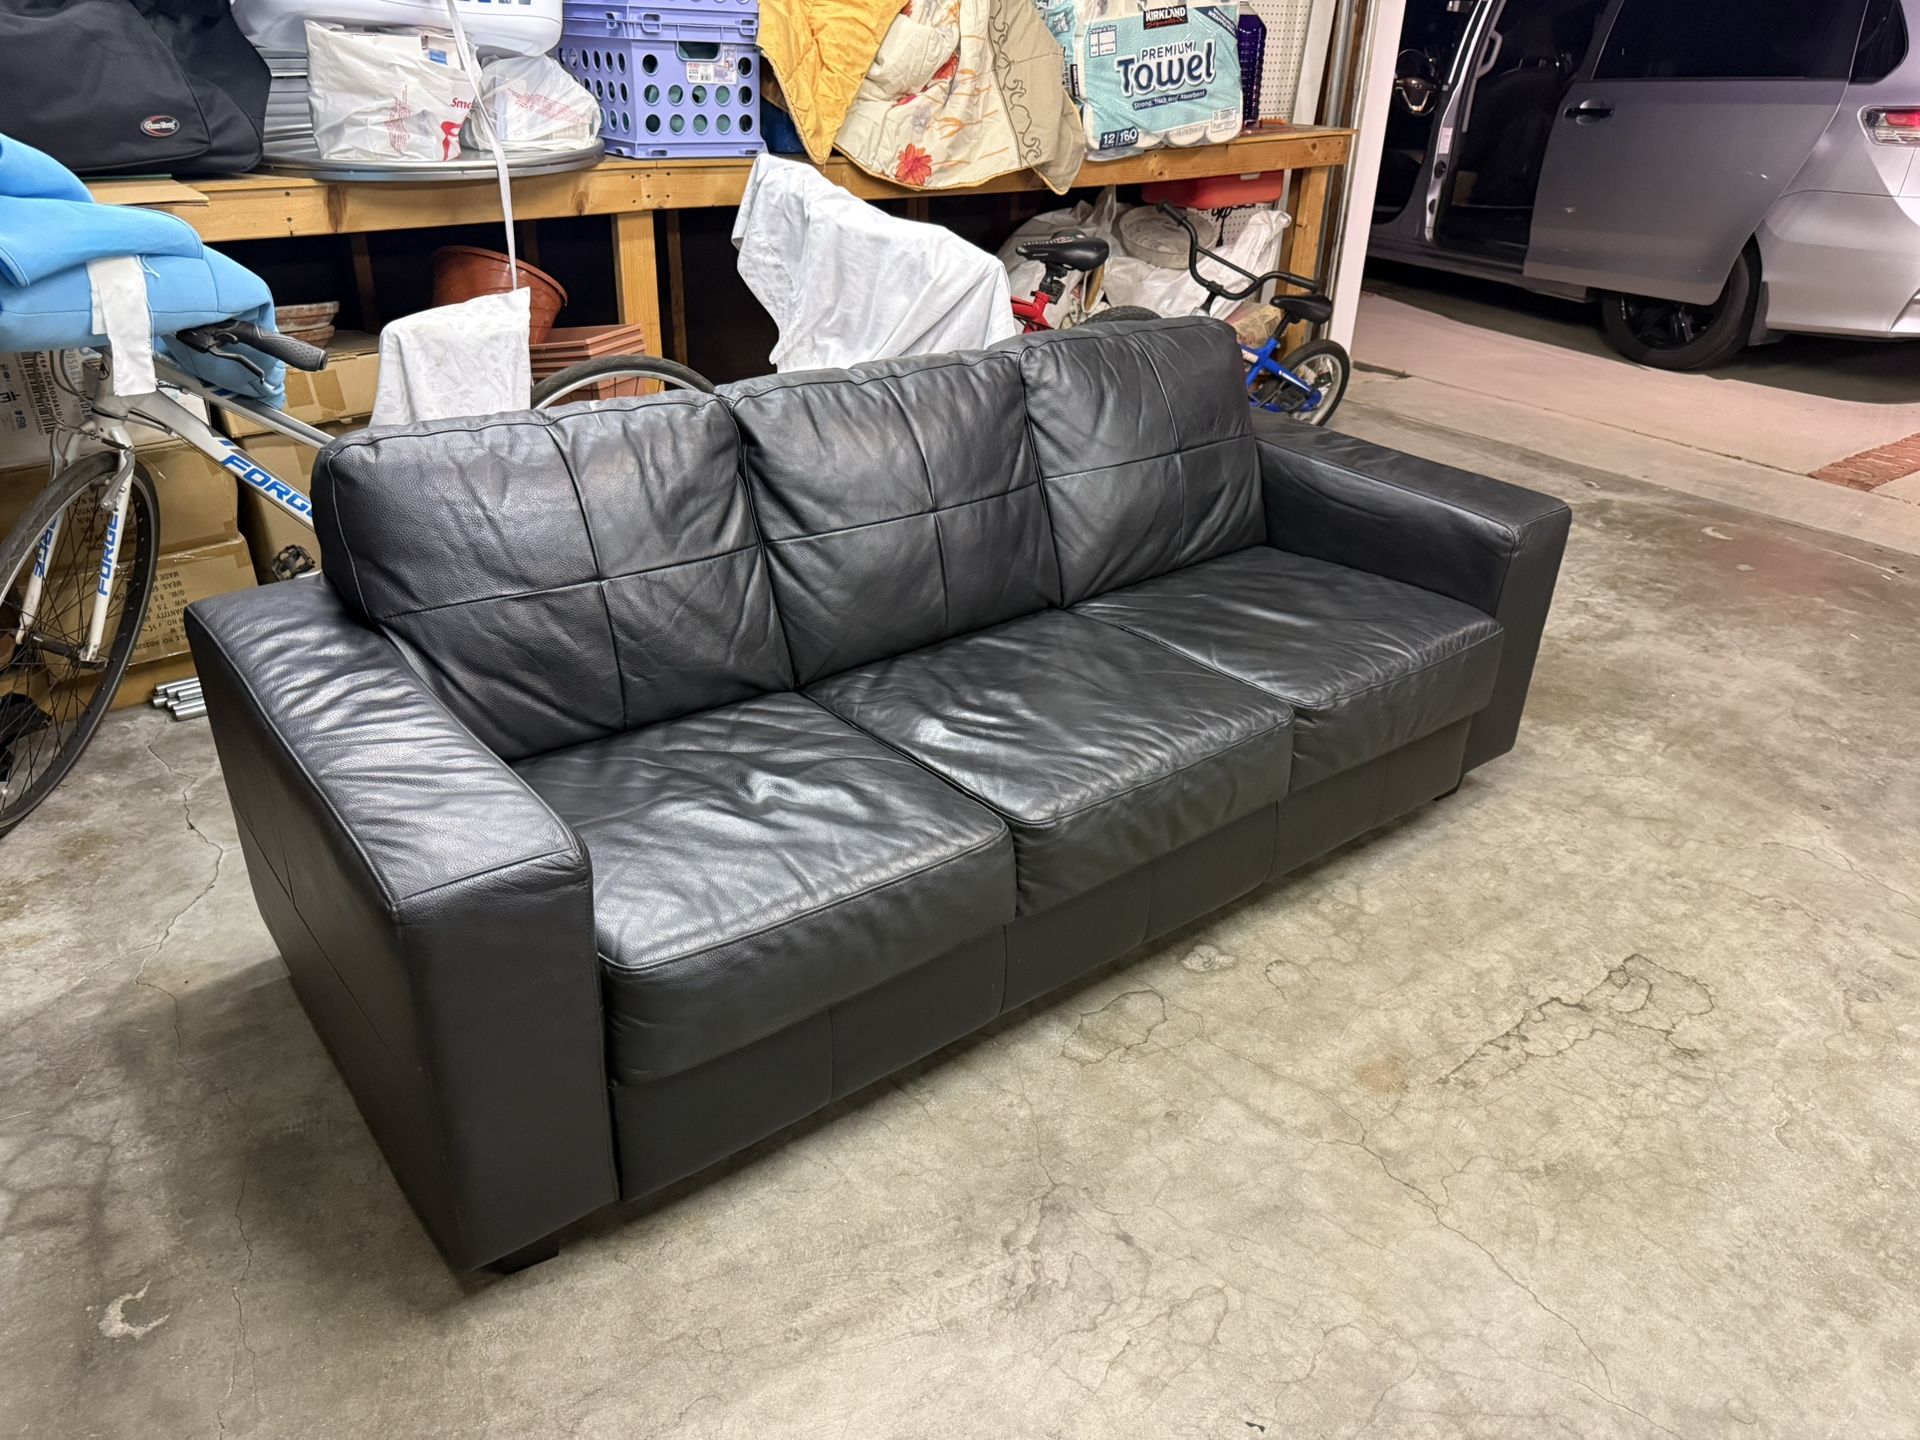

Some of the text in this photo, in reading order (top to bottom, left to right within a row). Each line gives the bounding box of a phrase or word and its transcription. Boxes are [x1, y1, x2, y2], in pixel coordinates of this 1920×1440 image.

[1145, 6, 1187, 22] KIRKLAND
[1142, 41, 1197, 60] PREMIUM
[1116, 41, 1214, 94] Towel
[1103, 133, 1116, 145] 12
[1120, 128, 1138, 143] 160
[220, 455, 313, 518] FORG
[98, 511, 119, 596] FORGE
[159, 570, 179, 580] MADE
